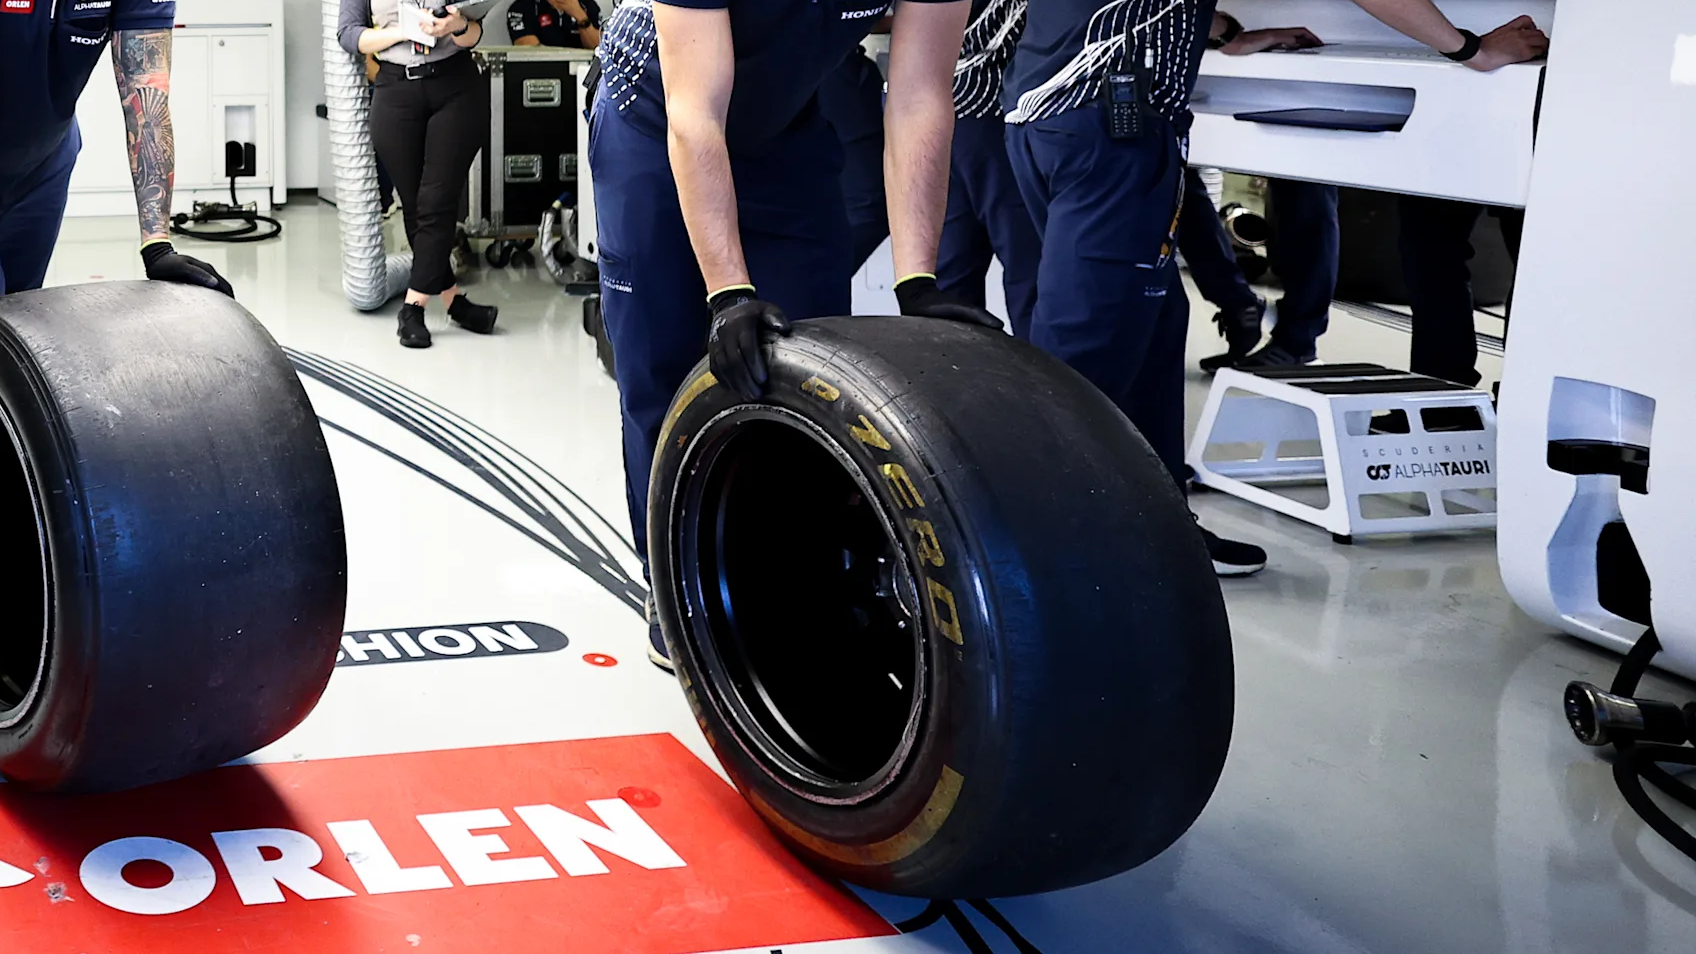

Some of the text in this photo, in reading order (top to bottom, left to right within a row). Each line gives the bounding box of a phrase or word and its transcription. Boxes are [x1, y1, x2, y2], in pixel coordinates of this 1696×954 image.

[6, 0, 31, 9] ORLEN
[1361, 442, 1485, 459] SCUDERIA
[1394, 459, 1491, 480] ALPHATAURI
[802, 372, 965, 647] P ZERO
[78, 796, 688, 917] ORLEN
